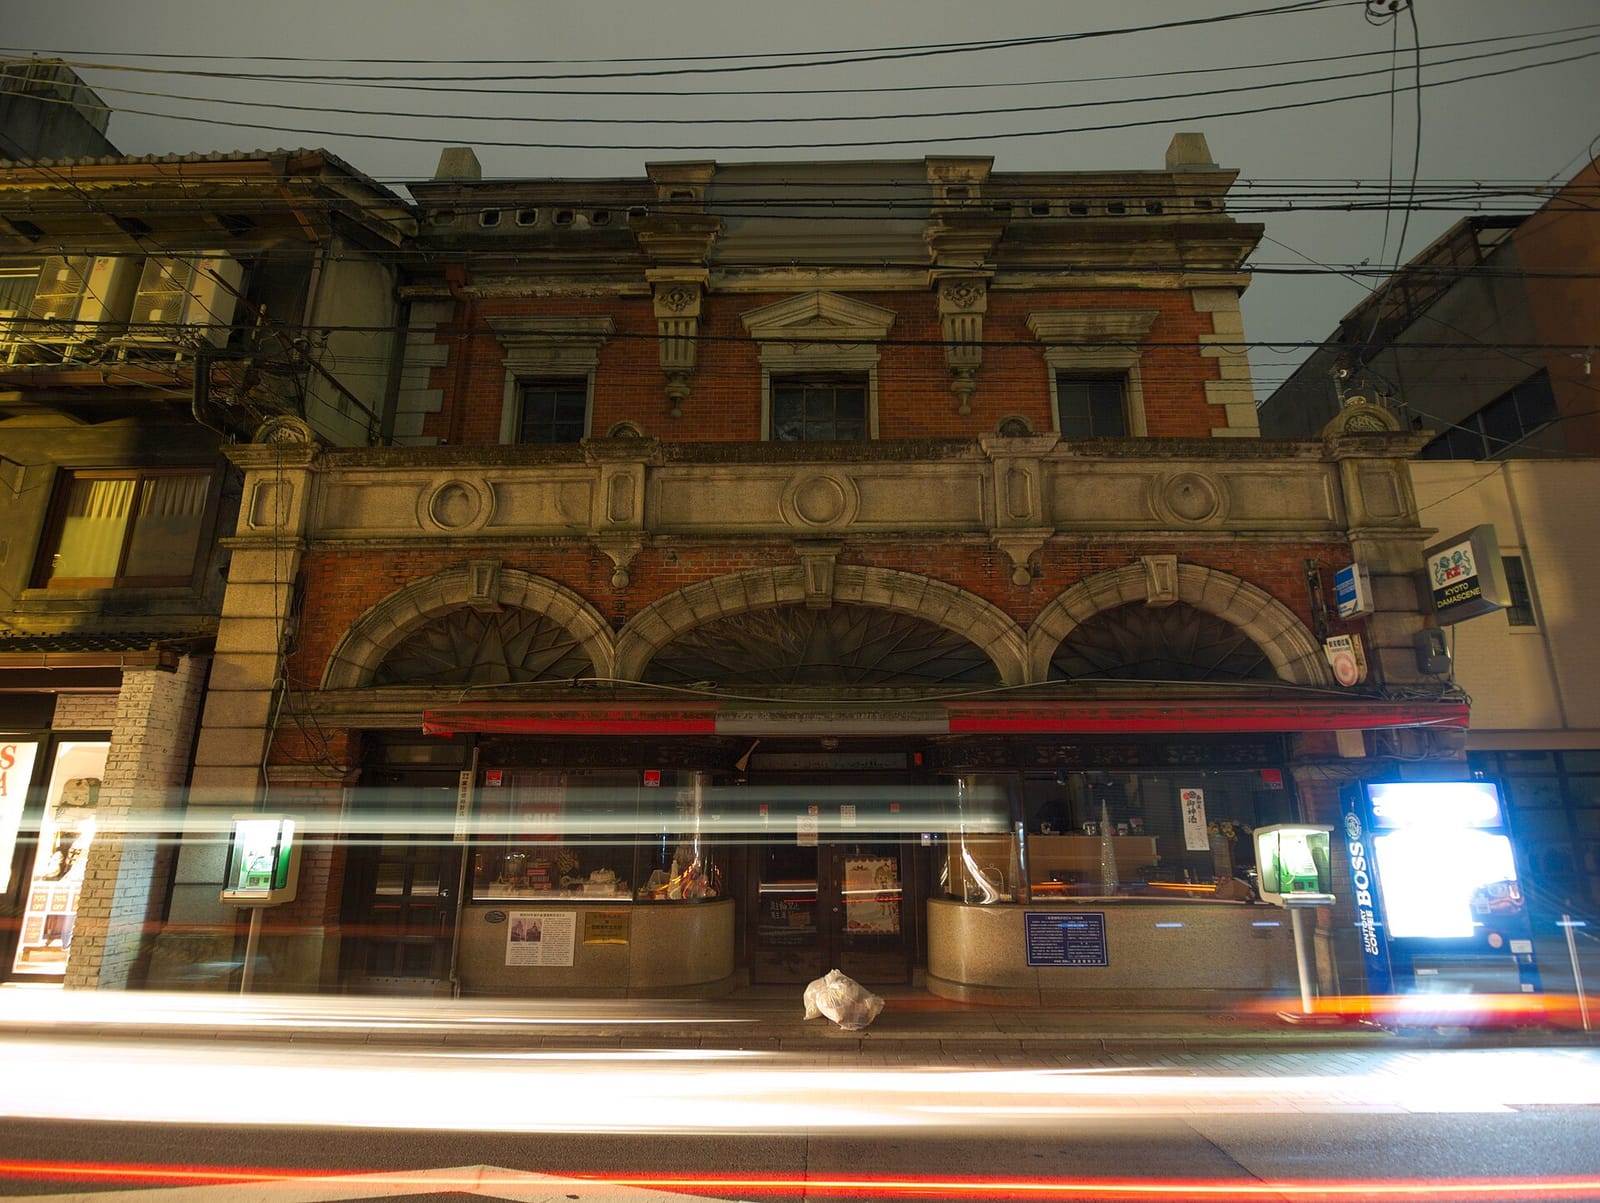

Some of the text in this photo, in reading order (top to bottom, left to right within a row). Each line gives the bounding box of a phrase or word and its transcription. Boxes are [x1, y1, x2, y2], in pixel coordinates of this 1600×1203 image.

[1437, 587, 1481, 608] DAMASCENE
[1445, 582, 1469, 596] KYOTO
[1350, 842, 1373, 908] BOSS
[1359, 909, 1372, 953] SUNTORY
[1364, 910, 1379, 955] COFFEE
